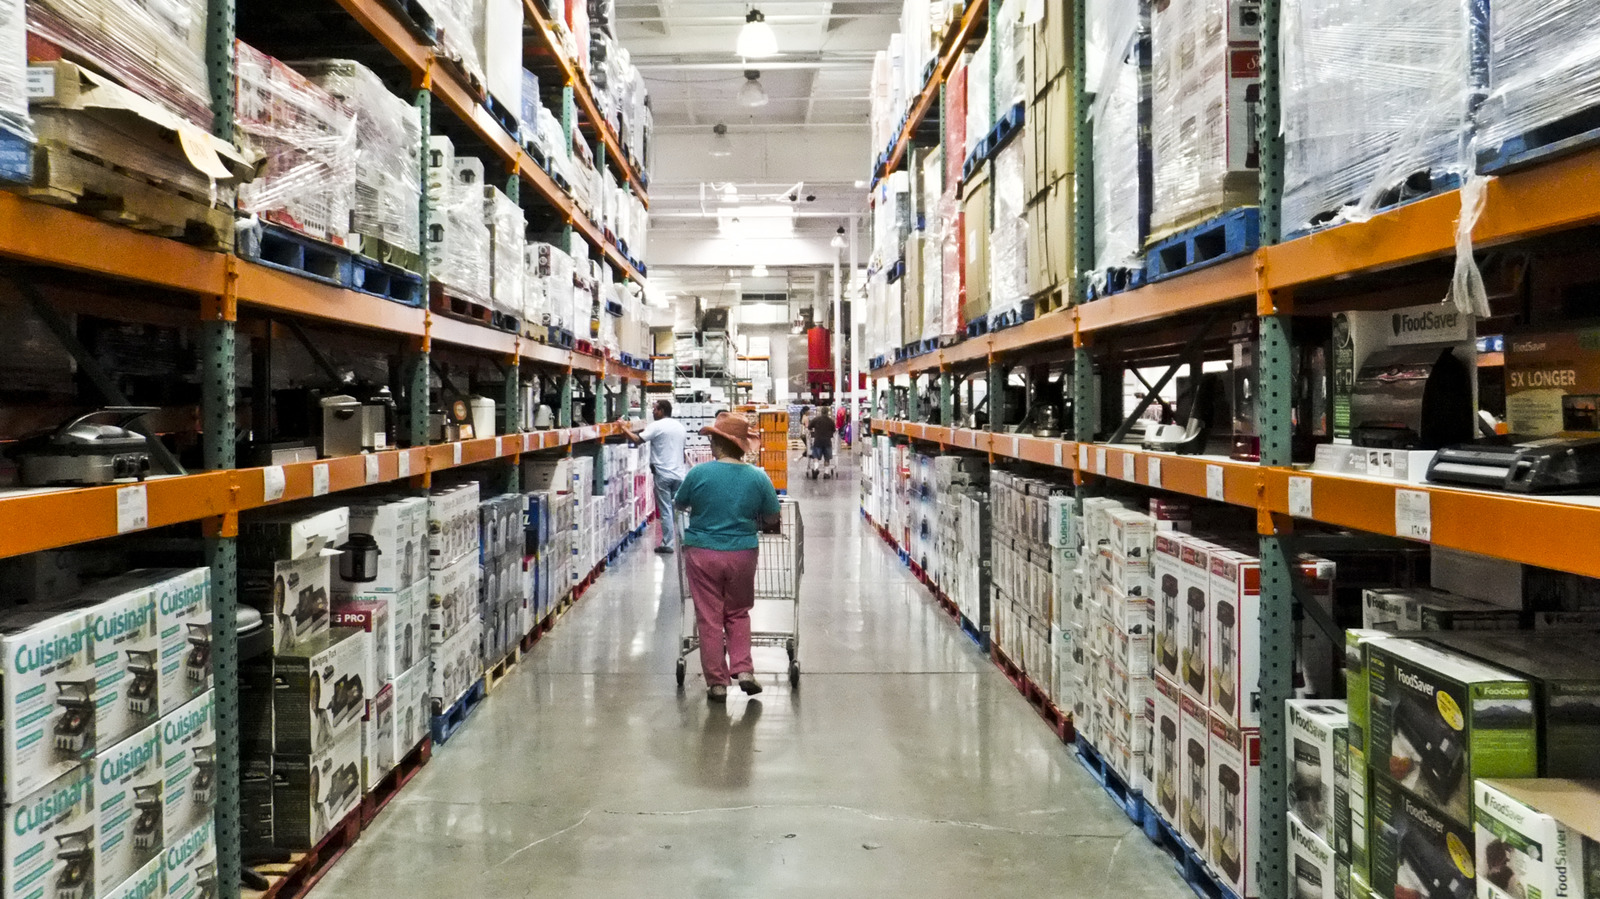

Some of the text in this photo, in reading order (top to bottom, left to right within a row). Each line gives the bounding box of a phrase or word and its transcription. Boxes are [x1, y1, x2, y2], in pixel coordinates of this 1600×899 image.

[1401, 311, 1459, 332] FoodSaver
[1527, 369, 1576, 387] LONGER
[1059, 502, 1068, 546] Cuisinart
[161, 581, 211, 616] Cuisinart
[94, 600, 156, 644] Cuisinart
[344, 614, 366, 623] PRO
[15, 624, 95, 675] Cuisinart
[1397, 667, 1435, 697] FoodSaver
[1484, 687, 1529, 696] FoodSaver
[164, 699, 215, 745] Cuisinart
[1296, 710, 1328, 743] FoodSaver
[100, 729, 162, 786] Cuisinart
[14, 771, 94, 837] Cuisinart
[1405, 798, 1445, 834] FoodSaver
[1490, 796, 1525, 825] FoodSaver
[167, 816, 215, 872] Cuisinart
[1297, 826, 1329, 866] FoodSaver
[1555, 828, 1569, 898] FoodSaver
